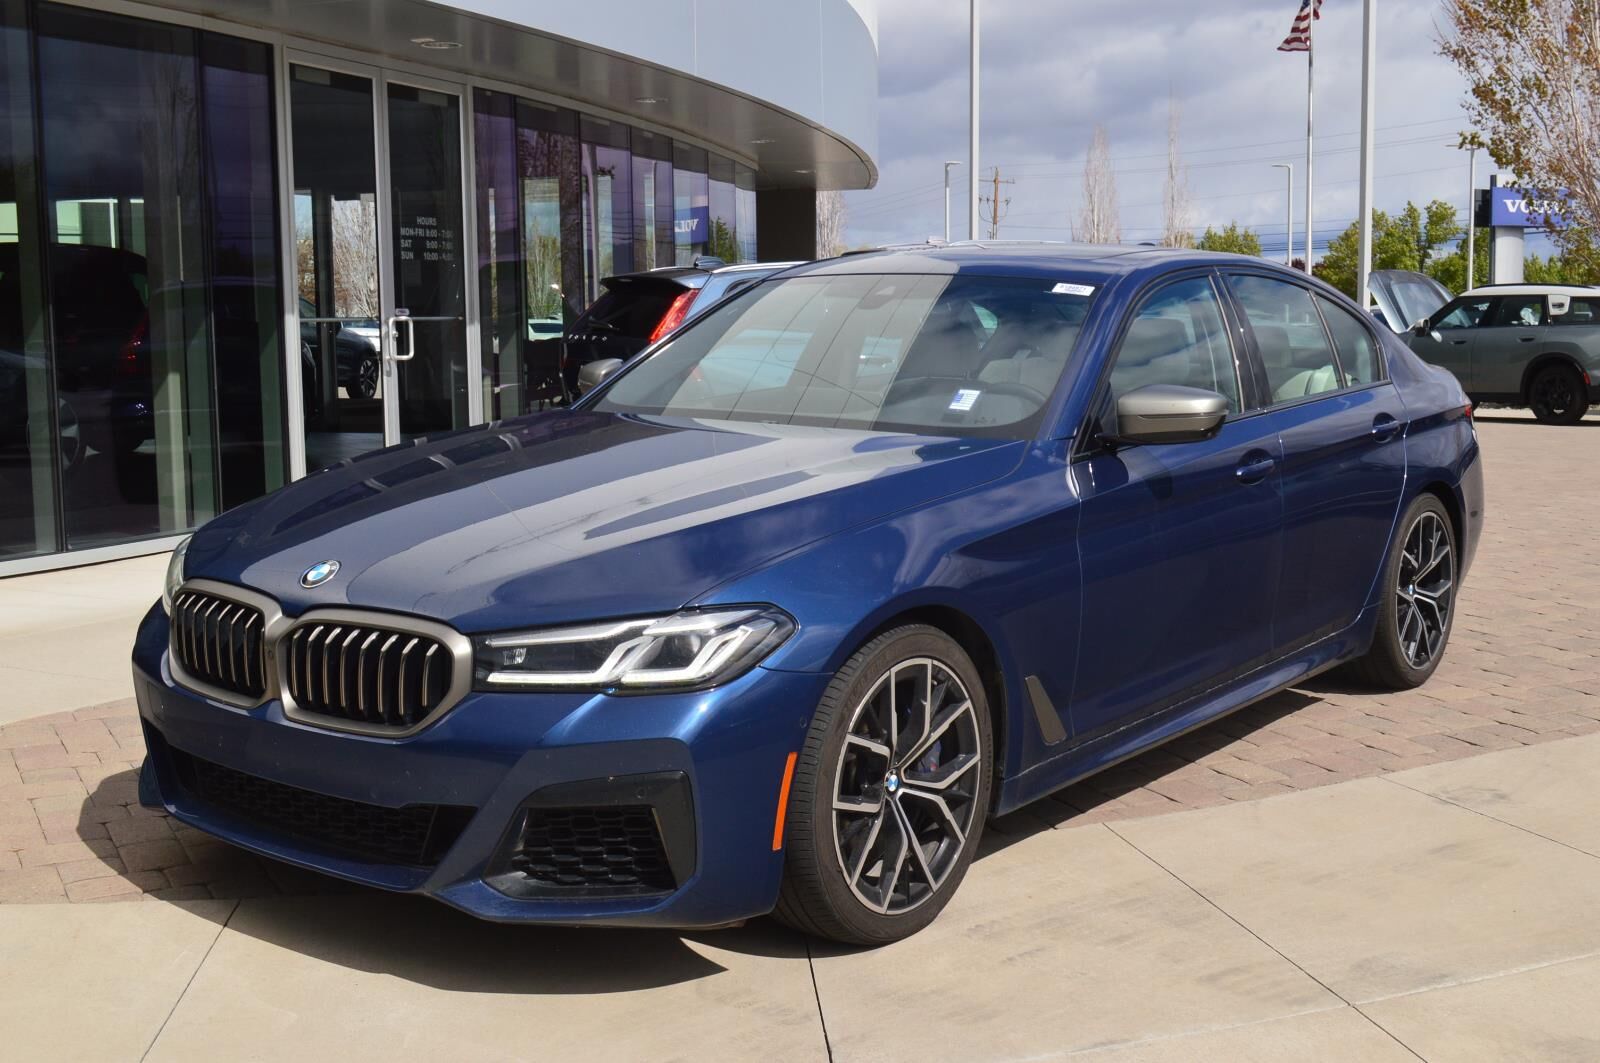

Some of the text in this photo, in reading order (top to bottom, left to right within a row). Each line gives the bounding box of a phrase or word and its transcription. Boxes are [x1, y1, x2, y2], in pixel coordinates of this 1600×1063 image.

[416, 216, 437, 226] HOURS
[400, 239, 412, 248] SAT
[401, 251, 414, 260] SUN
